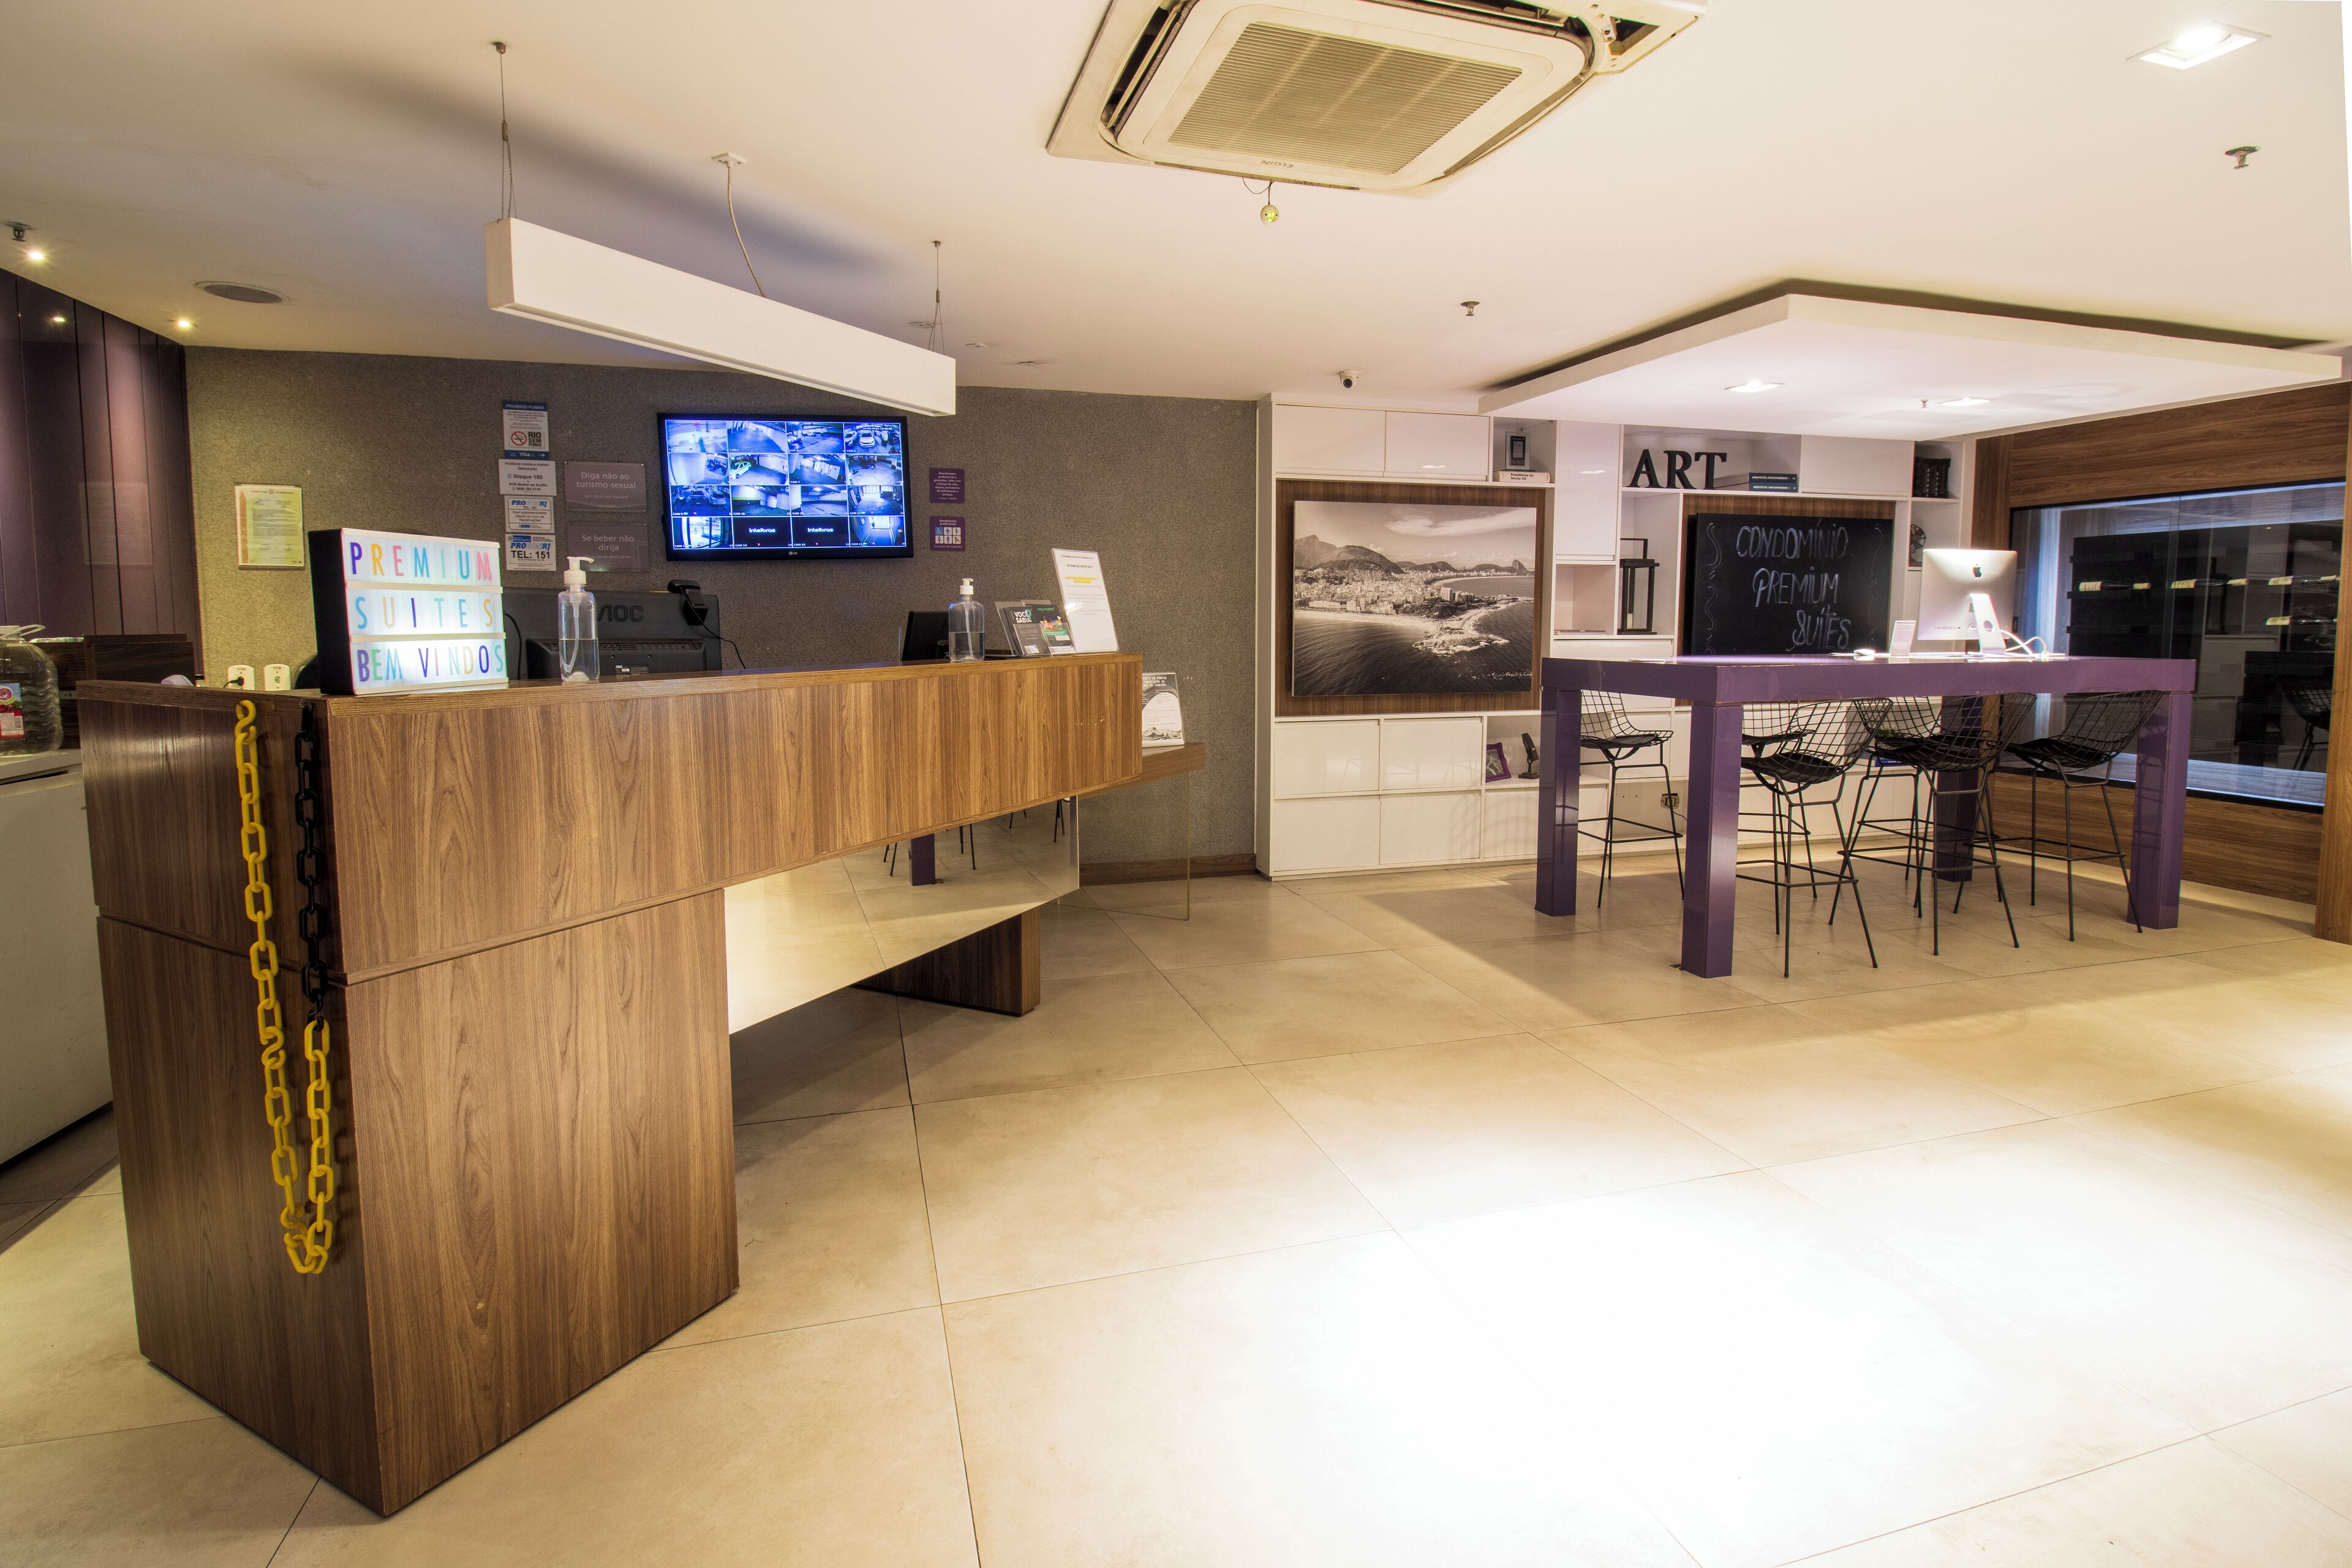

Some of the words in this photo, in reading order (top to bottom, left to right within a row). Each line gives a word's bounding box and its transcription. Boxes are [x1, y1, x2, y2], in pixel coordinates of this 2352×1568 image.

[1261, 160, 1294, 168] ELGIN
[581, 472, 600, 480] Diga
[1625, 448, 1728, 490] ART
[350, 541, 492, 581] PREMIUM
[598, 544, 619, 552] dirija
[355, 596, 493, 630] SUITES
[597, 604, 643, 622] AOC
[356, 648, 403, 682] BEM
[418, 644, 504, 678] VINDOS
